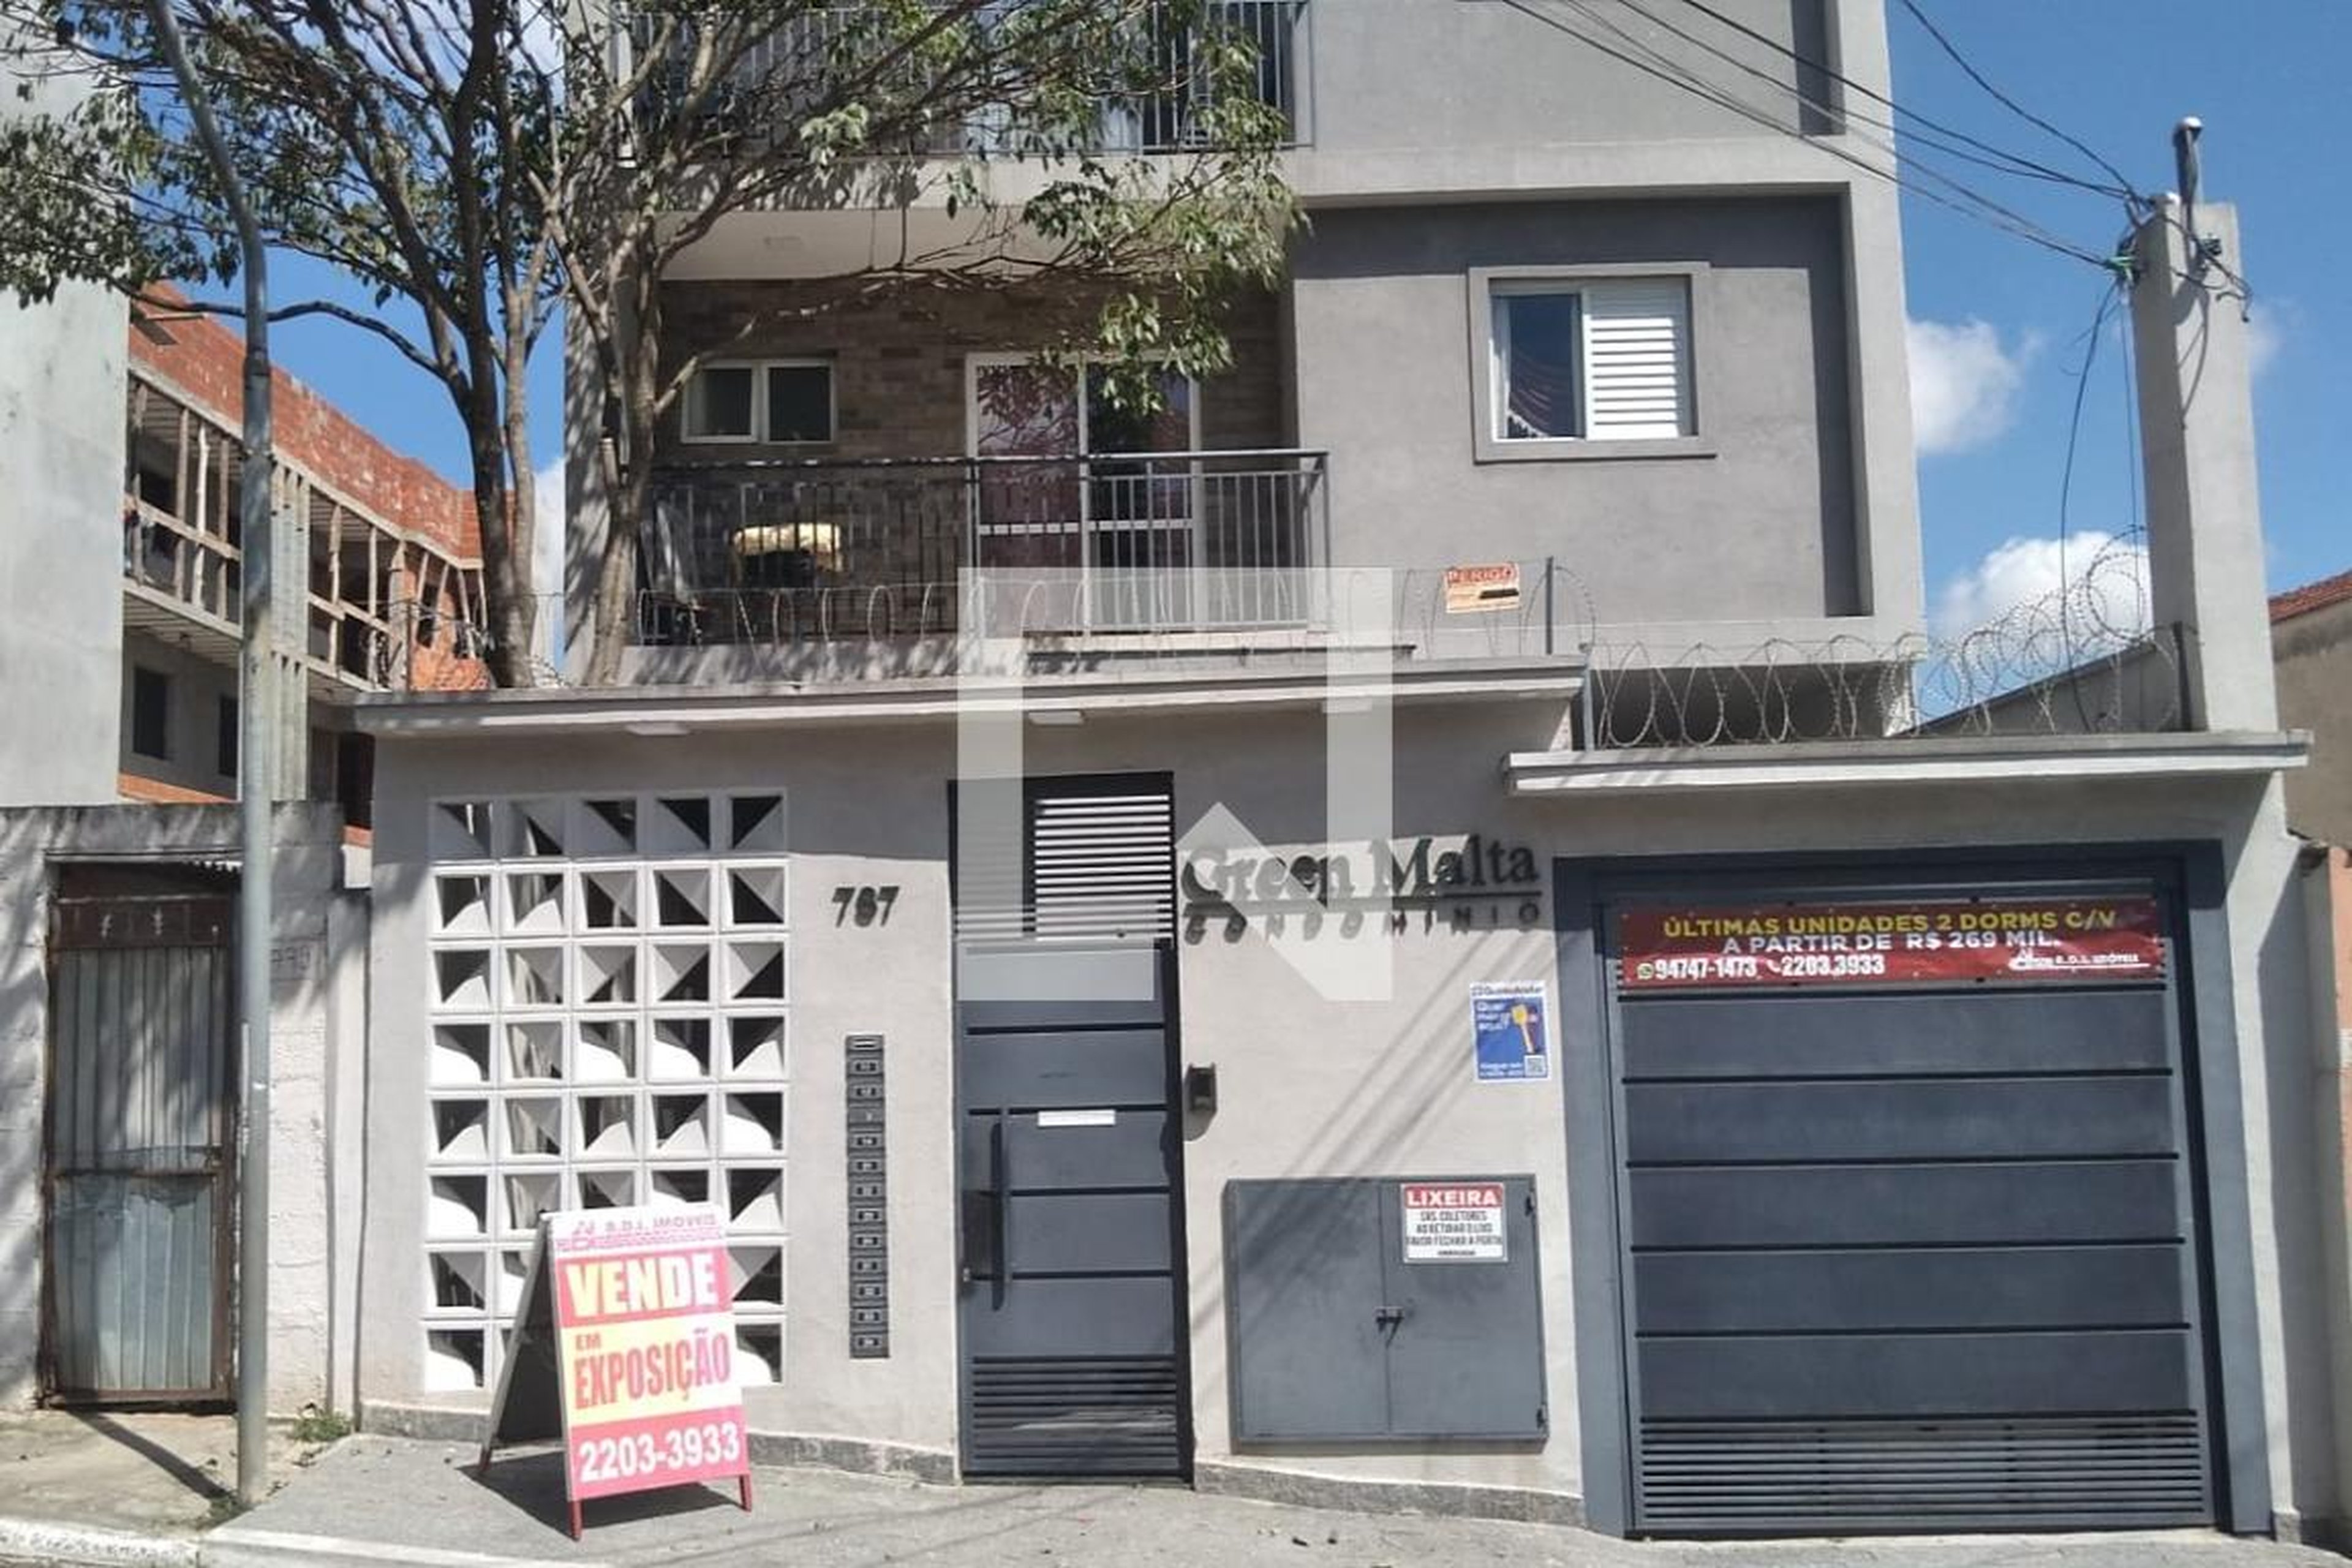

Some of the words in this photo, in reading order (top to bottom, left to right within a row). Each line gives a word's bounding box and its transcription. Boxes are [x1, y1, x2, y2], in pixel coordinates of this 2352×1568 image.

[1181, 849, 1355, 901] Green
[1371, 835, 1540, 888] Malta
[1664, 916, 1780, 937] ÚLTIMAS
[1788, 914, 1928, 935] UNIDADES
[1937, 915, 1953, 931] 2
[1961, 912, 2057, 930] DORMS
[1723, 938, 1742, 954] A
[1750, 935, 1852, 952] PARTIR
[1856, 933, 1893, 950] DE
[1906, 932, 1942, 950] R$
[1948, 931, 1997, 948] 269
[1655, 957, 1757, 979] 94747-1473
[1406, 1189, 1498, 1206] LIXEIRA
[565, 1253, 719, 1317] VENDE
[575, 1332, 601, 1351] EM
[574, 1327, 731, 1410] EXPOSIÇÃO
[579, 1420, 741, 1483] 2203-3933
